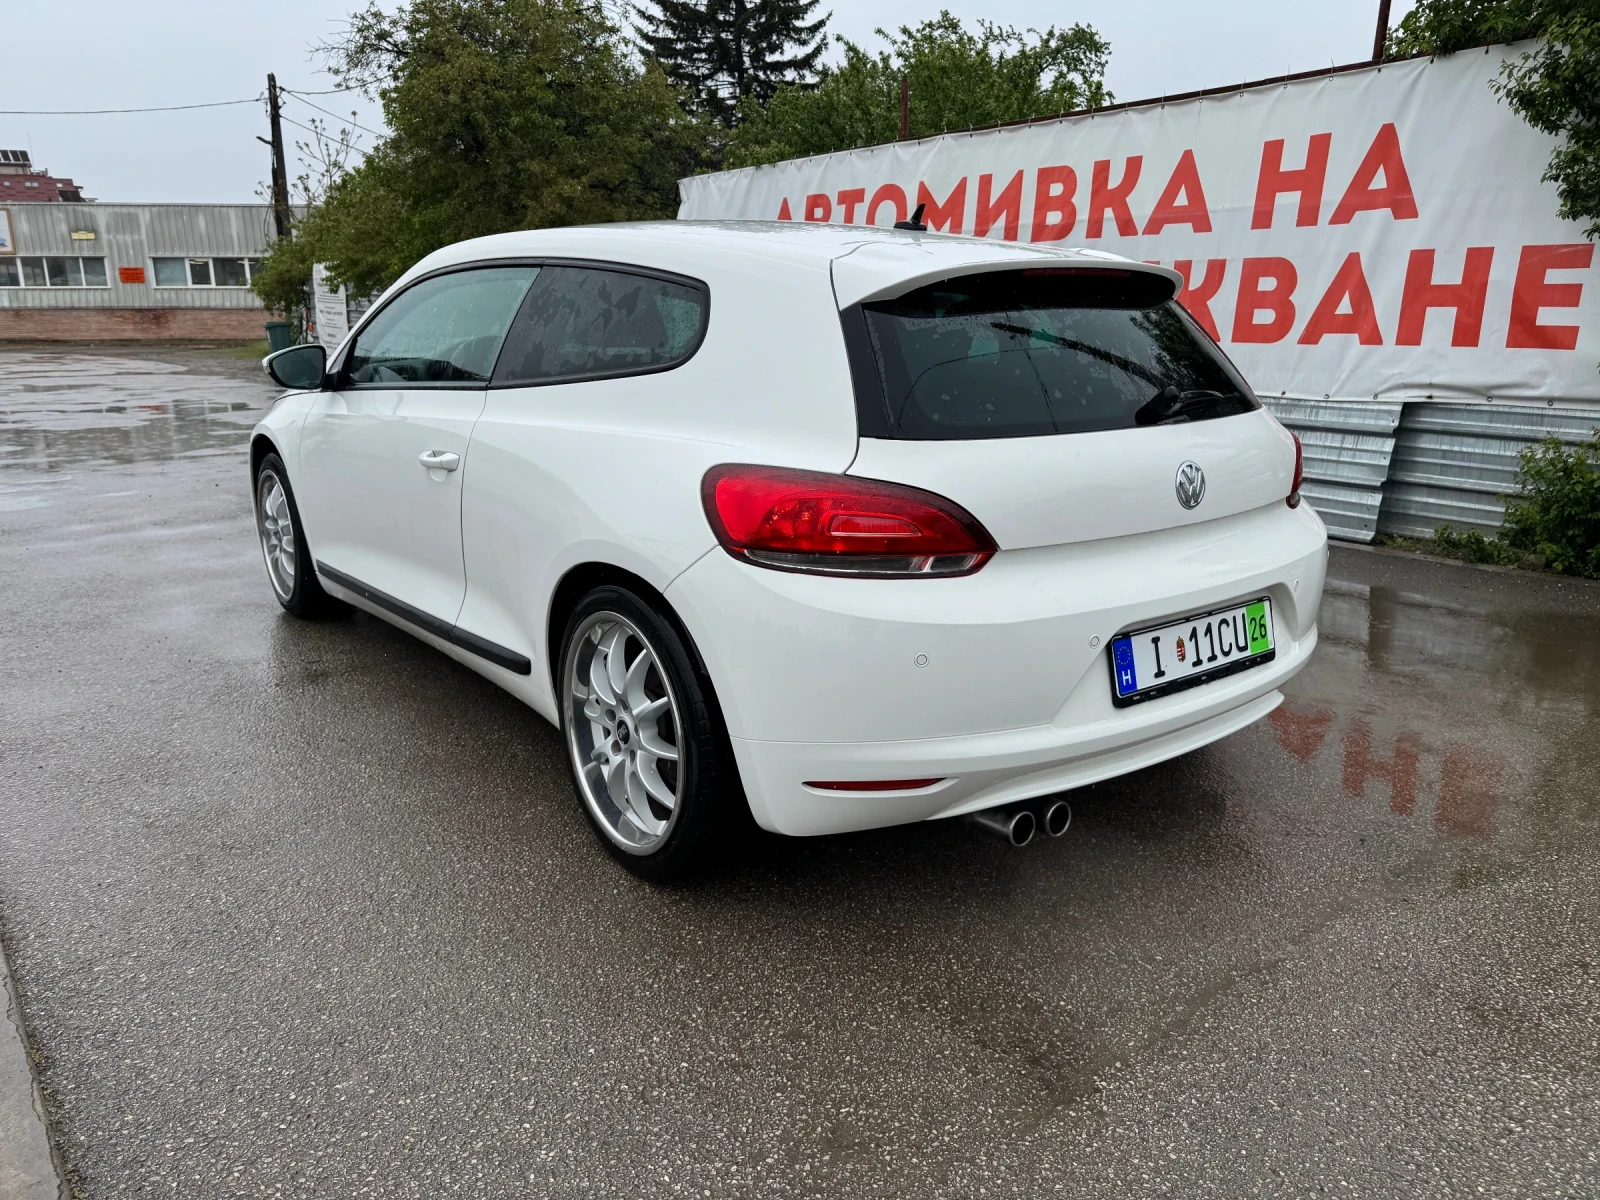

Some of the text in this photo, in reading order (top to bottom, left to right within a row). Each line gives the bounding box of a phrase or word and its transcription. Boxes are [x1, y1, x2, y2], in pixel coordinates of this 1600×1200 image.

[1251, 122, 1418, 230] НА
[1188, 612, 1249, 667] 11CU
[1249, 613, 1267, 642] 26
[1121, 669, 1132, 686] H
